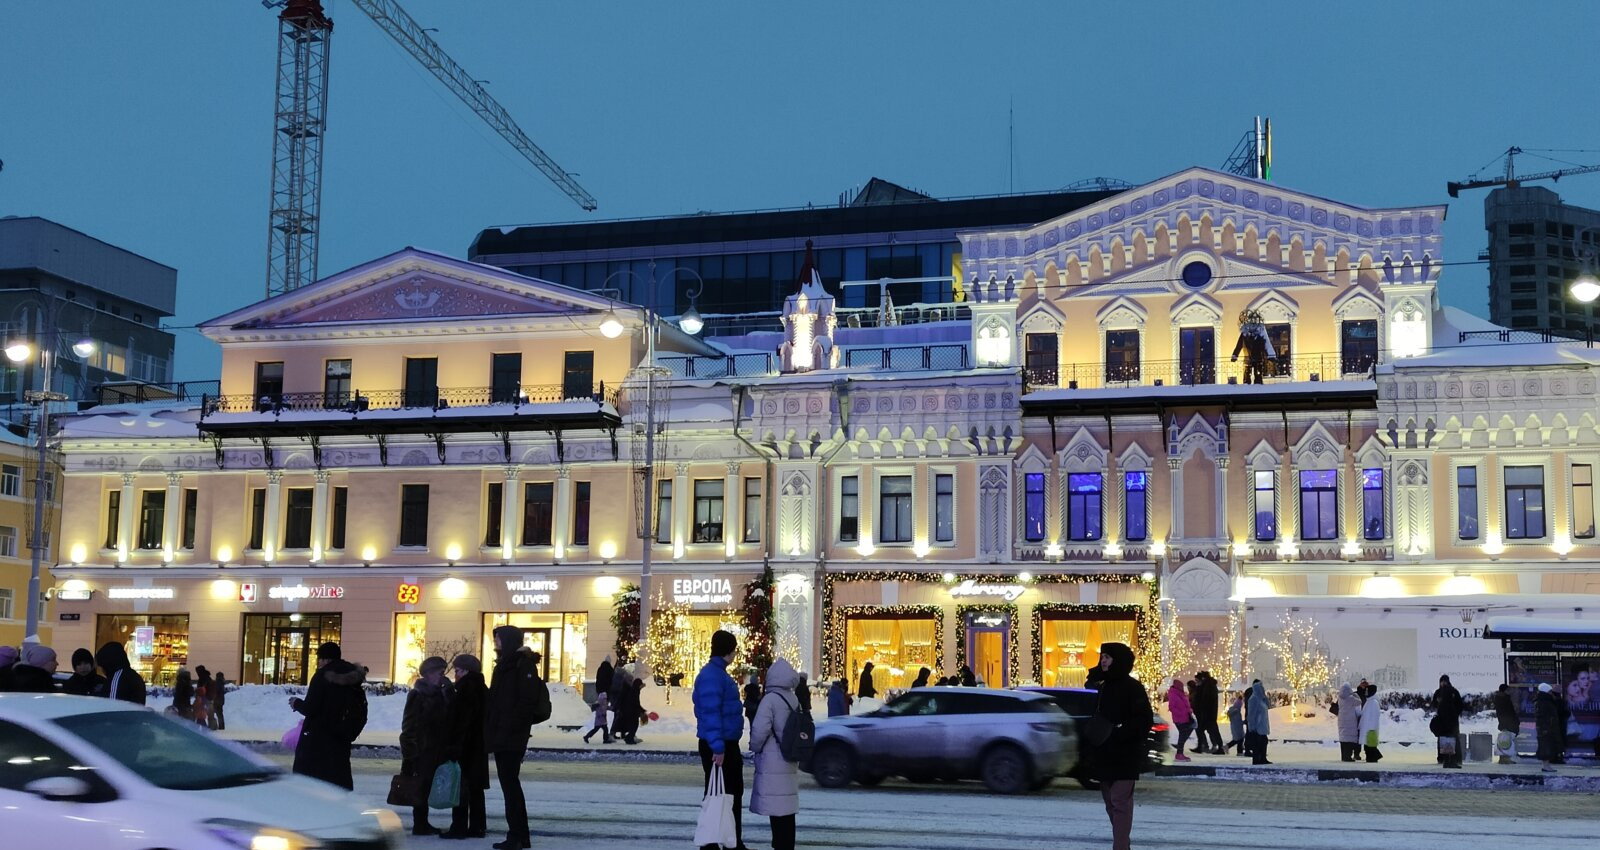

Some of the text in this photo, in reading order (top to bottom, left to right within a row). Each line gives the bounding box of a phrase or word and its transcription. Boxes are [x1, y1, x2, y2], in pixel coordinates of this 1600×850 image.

[673, 578, 732, 594] ЕВРОПА
[949, 580, 1025, 601] Mercury
[1439, 627, 1483, 638] ROLE
